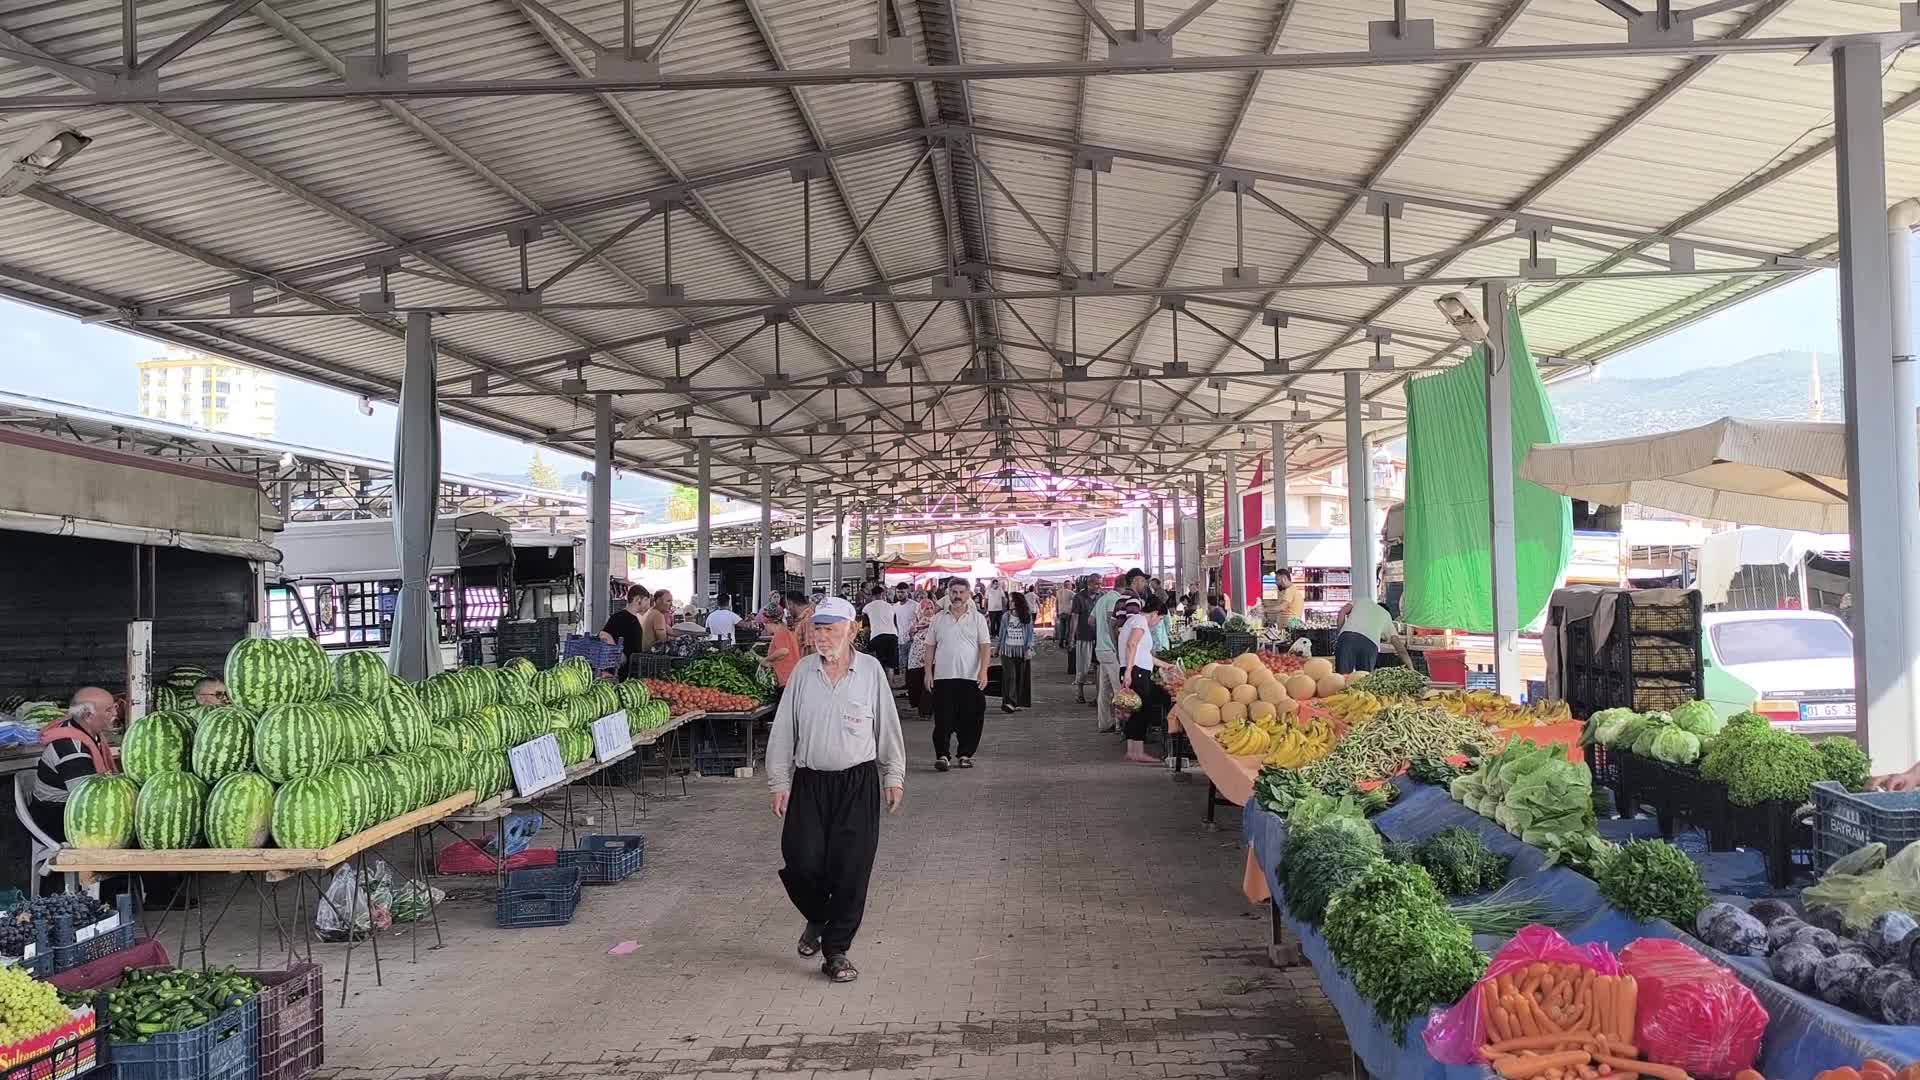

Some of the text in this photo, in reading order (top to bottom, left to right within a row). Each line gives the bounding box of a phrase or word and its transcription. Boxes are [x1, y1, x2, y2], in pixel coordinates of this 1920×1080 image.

[1808, 705, 1819, 716] 01
[1824, 705, 1838, 716] GS
[1830, 818, 1865, 843] BAYRAM
